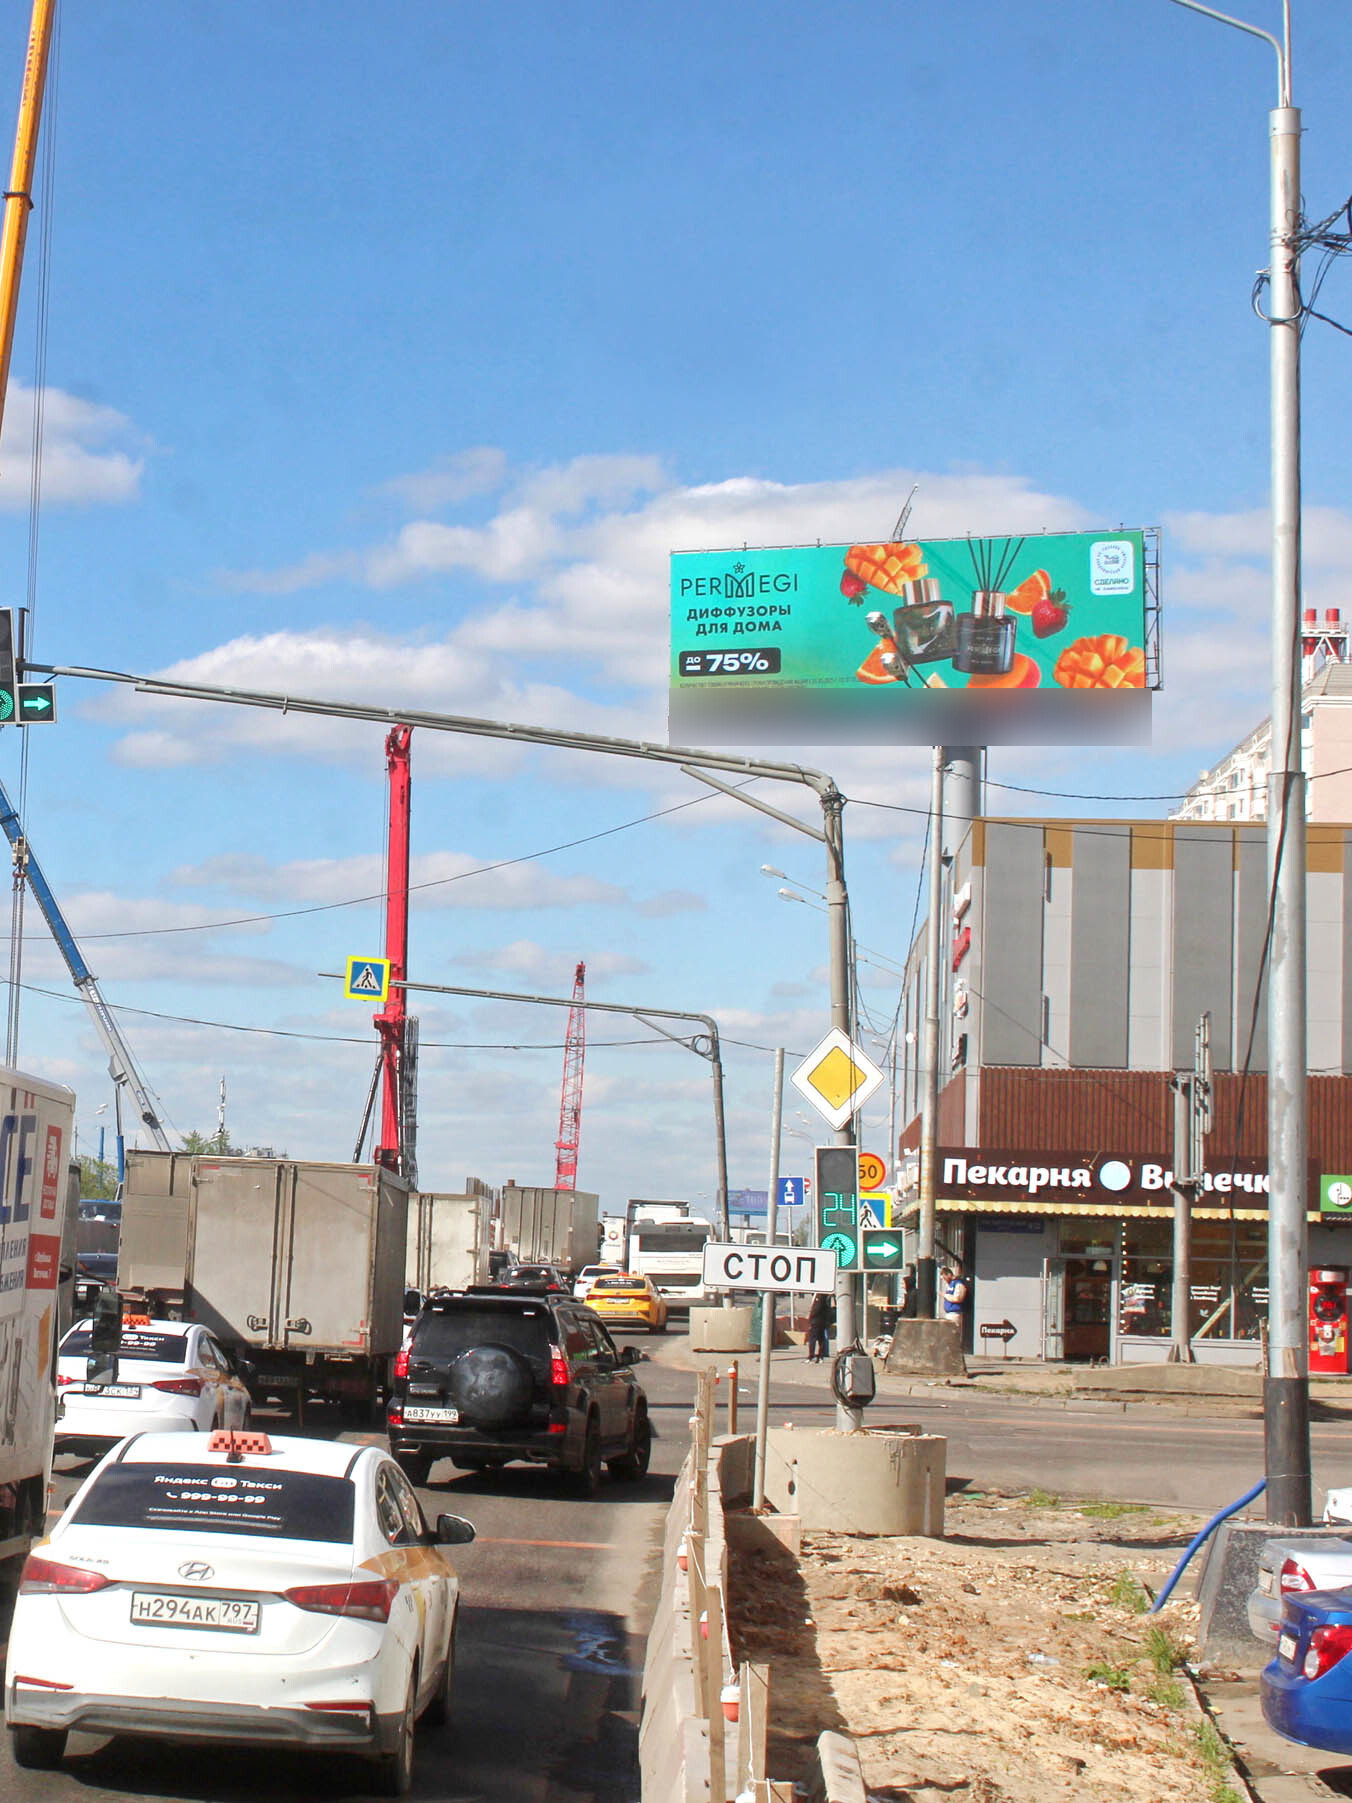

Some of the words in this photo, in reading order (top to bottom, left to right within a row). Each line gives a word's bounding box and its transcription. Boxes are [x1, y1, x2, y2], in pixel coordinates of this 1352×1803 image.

[680, 571, 798, 598] PERMEGI
[686, 604, 792, 622] ДИФФУЗОРЫ
[695, 622, 728, 637] ДЛЯ
[733, 620, 783, 635] ДОМА
[859, 1164, 877, 1179] 50
[943, 1157, 1093, 1194] Пекарня
[1140, 1163, 1270, 1194] Вечк
[823, 1193, 856, 1226] 24
[723, 1252, 816, 1284] СТОП
[154, 1475, 209, 1486] Яндекс
[240, 1479, 284, 1490] Такси
[180, 1491, 266, 1504] 999-99-99
[138, 1598, 217, 1622] Н294АК
[221, 1602, 252, 1620] 797
